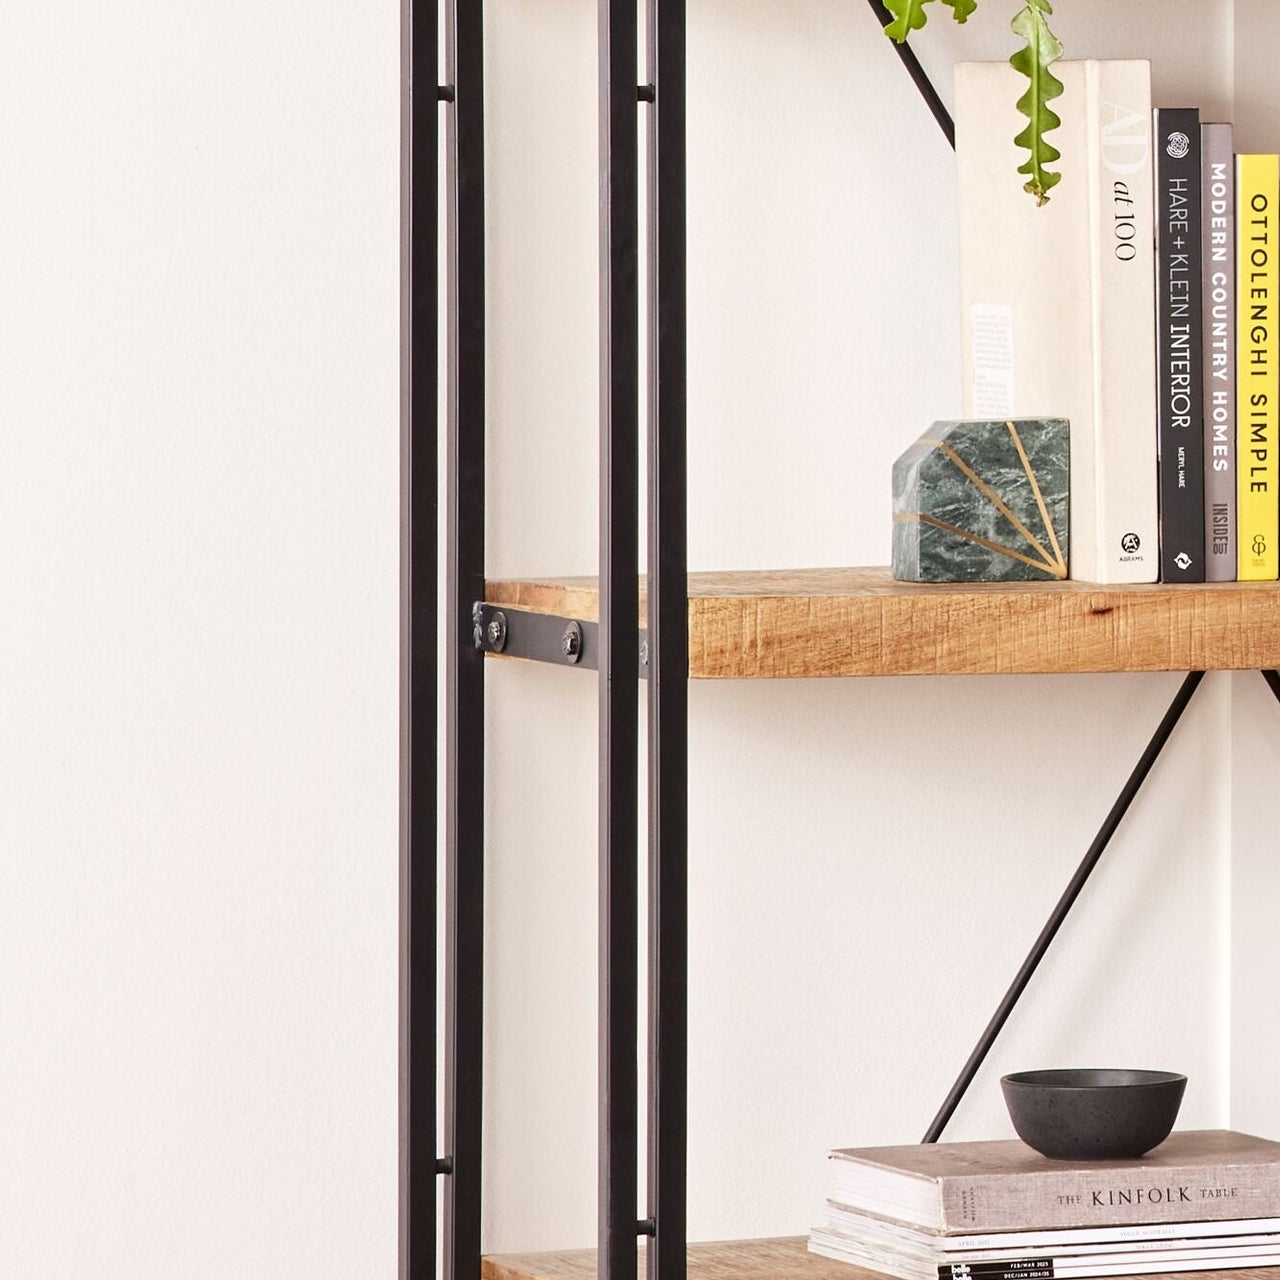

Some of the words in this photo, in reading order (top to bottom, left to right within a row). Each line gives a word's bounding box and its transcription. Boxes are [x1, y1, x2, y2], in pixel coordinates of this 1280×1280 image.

[1113, 181, 1134, 207] at
[1169, 178, 1188, 233] HARE
[1211, 163, 1227, 261] MODERN
[1114, 213, 1136, 261] 100
[1172, 236, 1186, 249] +
[1170, 254, 1189, 317] KLEIN
[1250, 194, 1268, 376] OTTOLENGHI
[1212, 272, 1228, 381] COUNTRY
[1170, 324, 1191, 427] INTERIOR
[1212, 391, 1229, 471] HOMES
[1250, 394, 1268, 492] SIMPLE
[1212, 503, 1228, 542] INSIDE
[1213, 543, 1228, 555] OUT
[1057, 1195, 1083, 1205] THE
[1092, 1186, 1192, 1206] KINFOLK
[1200, 1187, 1238, 1199] TABLE
[951, 1264, 971, 1274] belle
[1010, 1261, 1035, 1269] FEB/MAR
